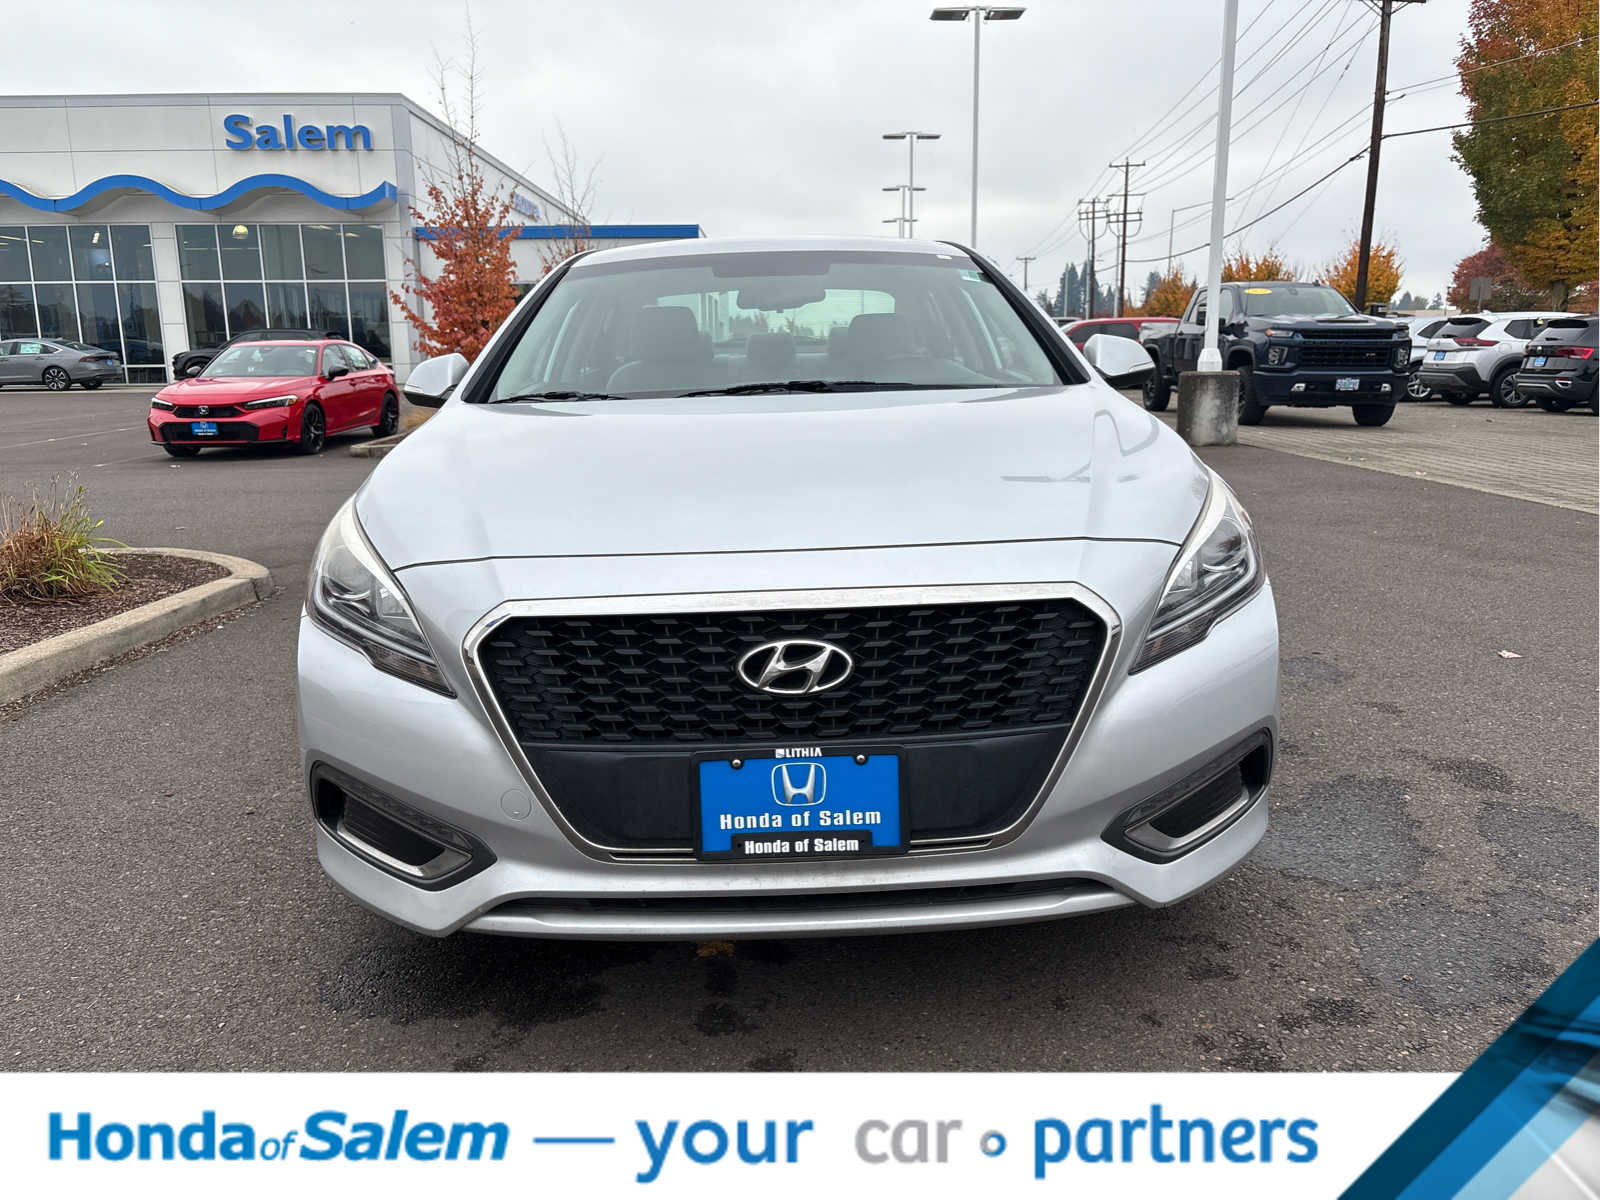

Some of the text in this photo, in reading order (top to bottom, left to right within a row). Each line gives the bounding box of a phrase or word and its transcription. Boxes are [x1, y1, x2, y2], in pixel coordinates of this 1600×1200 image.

[224, 114, 373, 151] Salem
[785, 747, 822, 758] LITHIA
[719, 810, 881, 830] Honda of Salem
[744, 837, 859, 855] Honda of Salem
